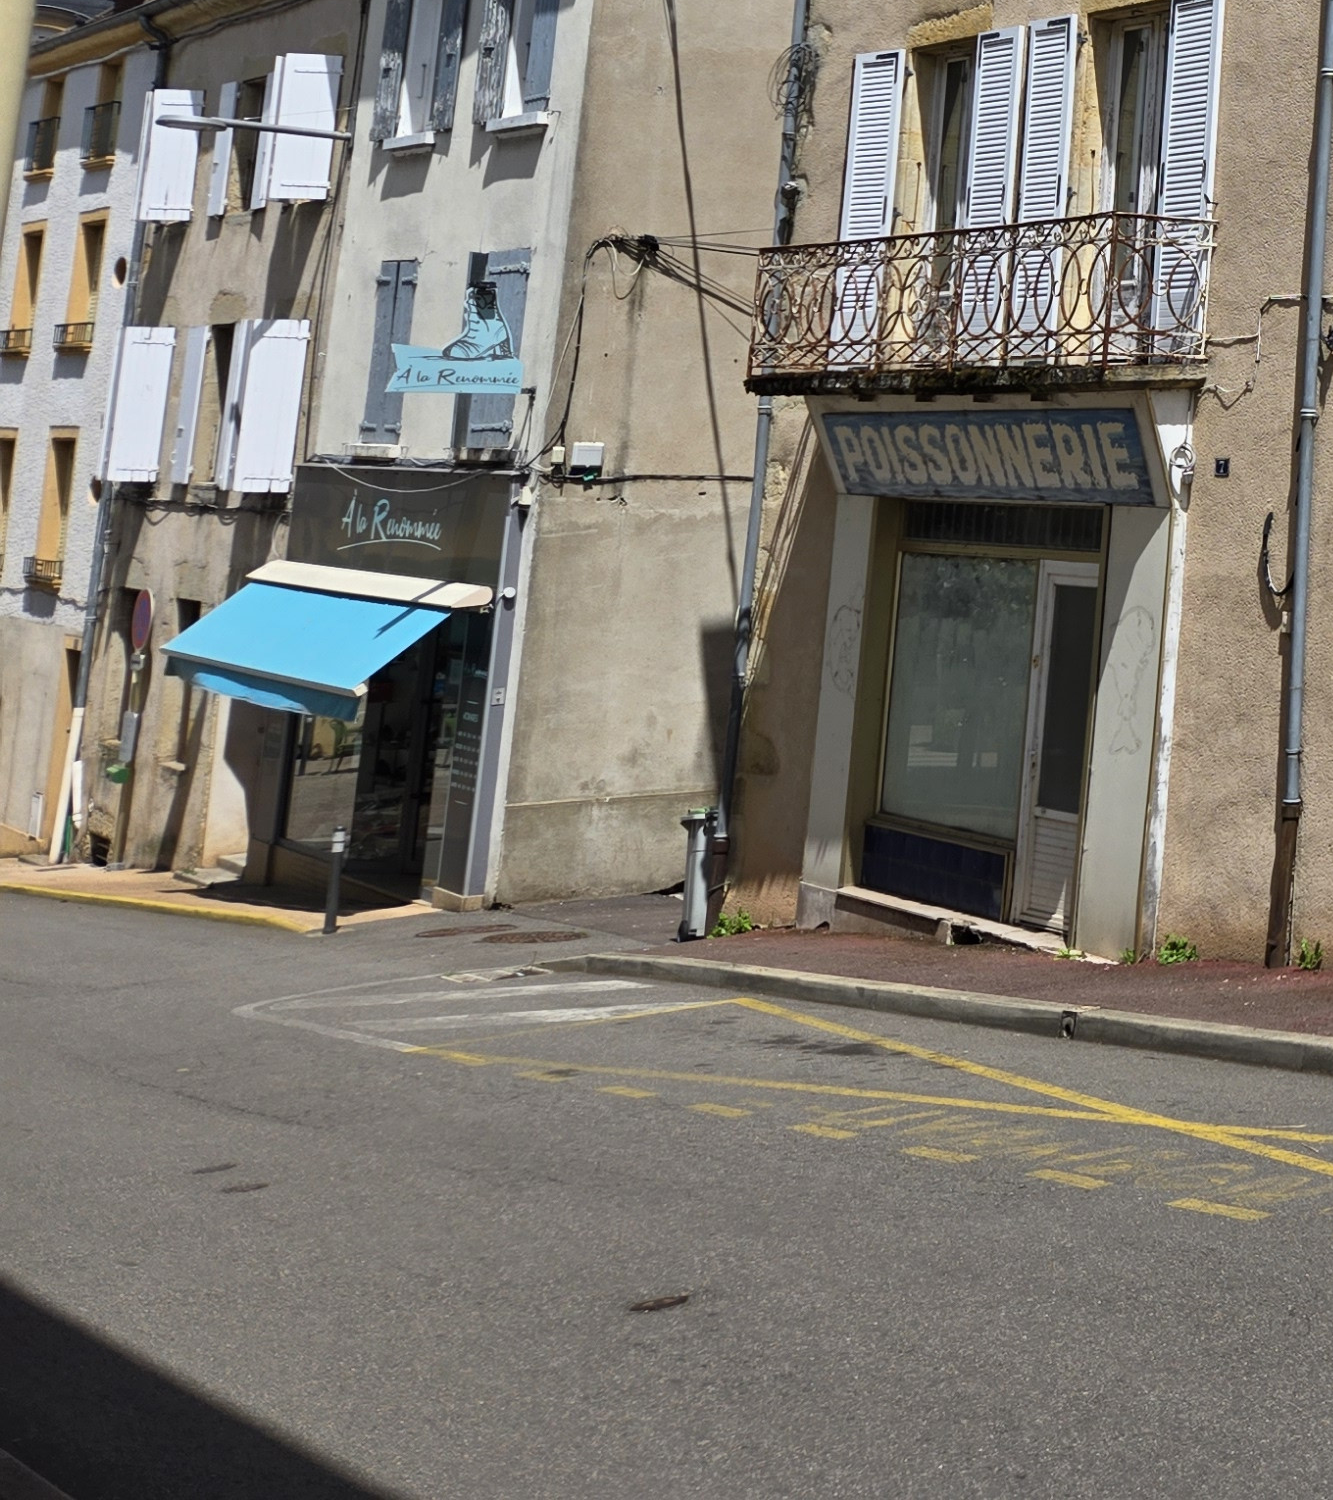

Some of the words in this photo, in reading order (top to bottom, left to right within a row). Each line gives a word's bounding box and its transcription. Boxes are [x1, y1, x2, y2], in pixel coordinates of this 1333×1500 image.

[416, 369, 431, 382] la
[437, 368, 519, 385] Renommée
[834, 421, 1139, 490] POISSONNERIE
[1218, 460, 1226, 473] 7
[356, 505, 368, 532] la
[370, 498, 441, 541] Renommée
